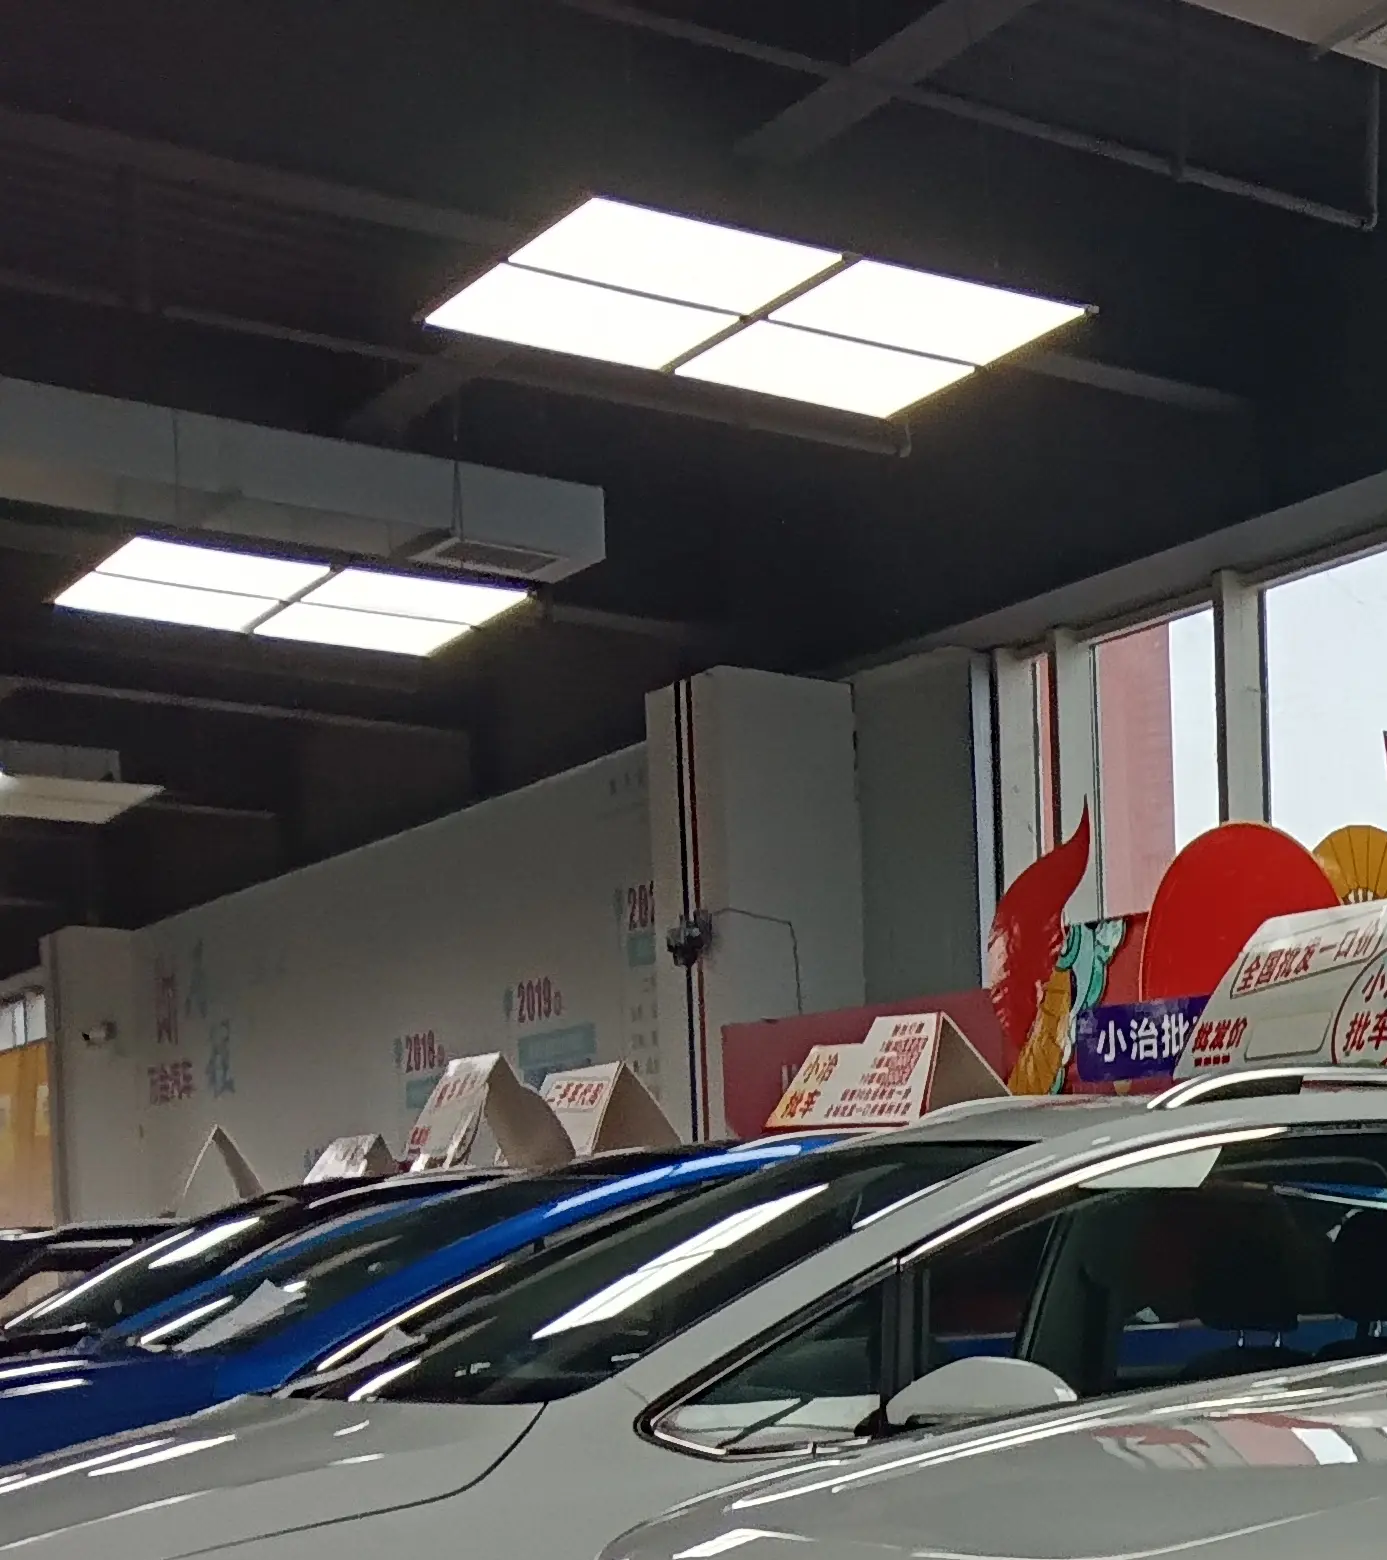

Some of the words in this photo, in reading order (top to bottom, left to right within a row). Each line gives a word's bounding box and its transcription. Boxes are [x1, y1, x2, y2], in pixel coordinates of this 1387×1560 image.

[1236, 918, 1380, 993] 全国批发一口价
[1096, 1012, 1198, 1063] 小治批
[1191, 1016, 1248, 1053] 批发价
